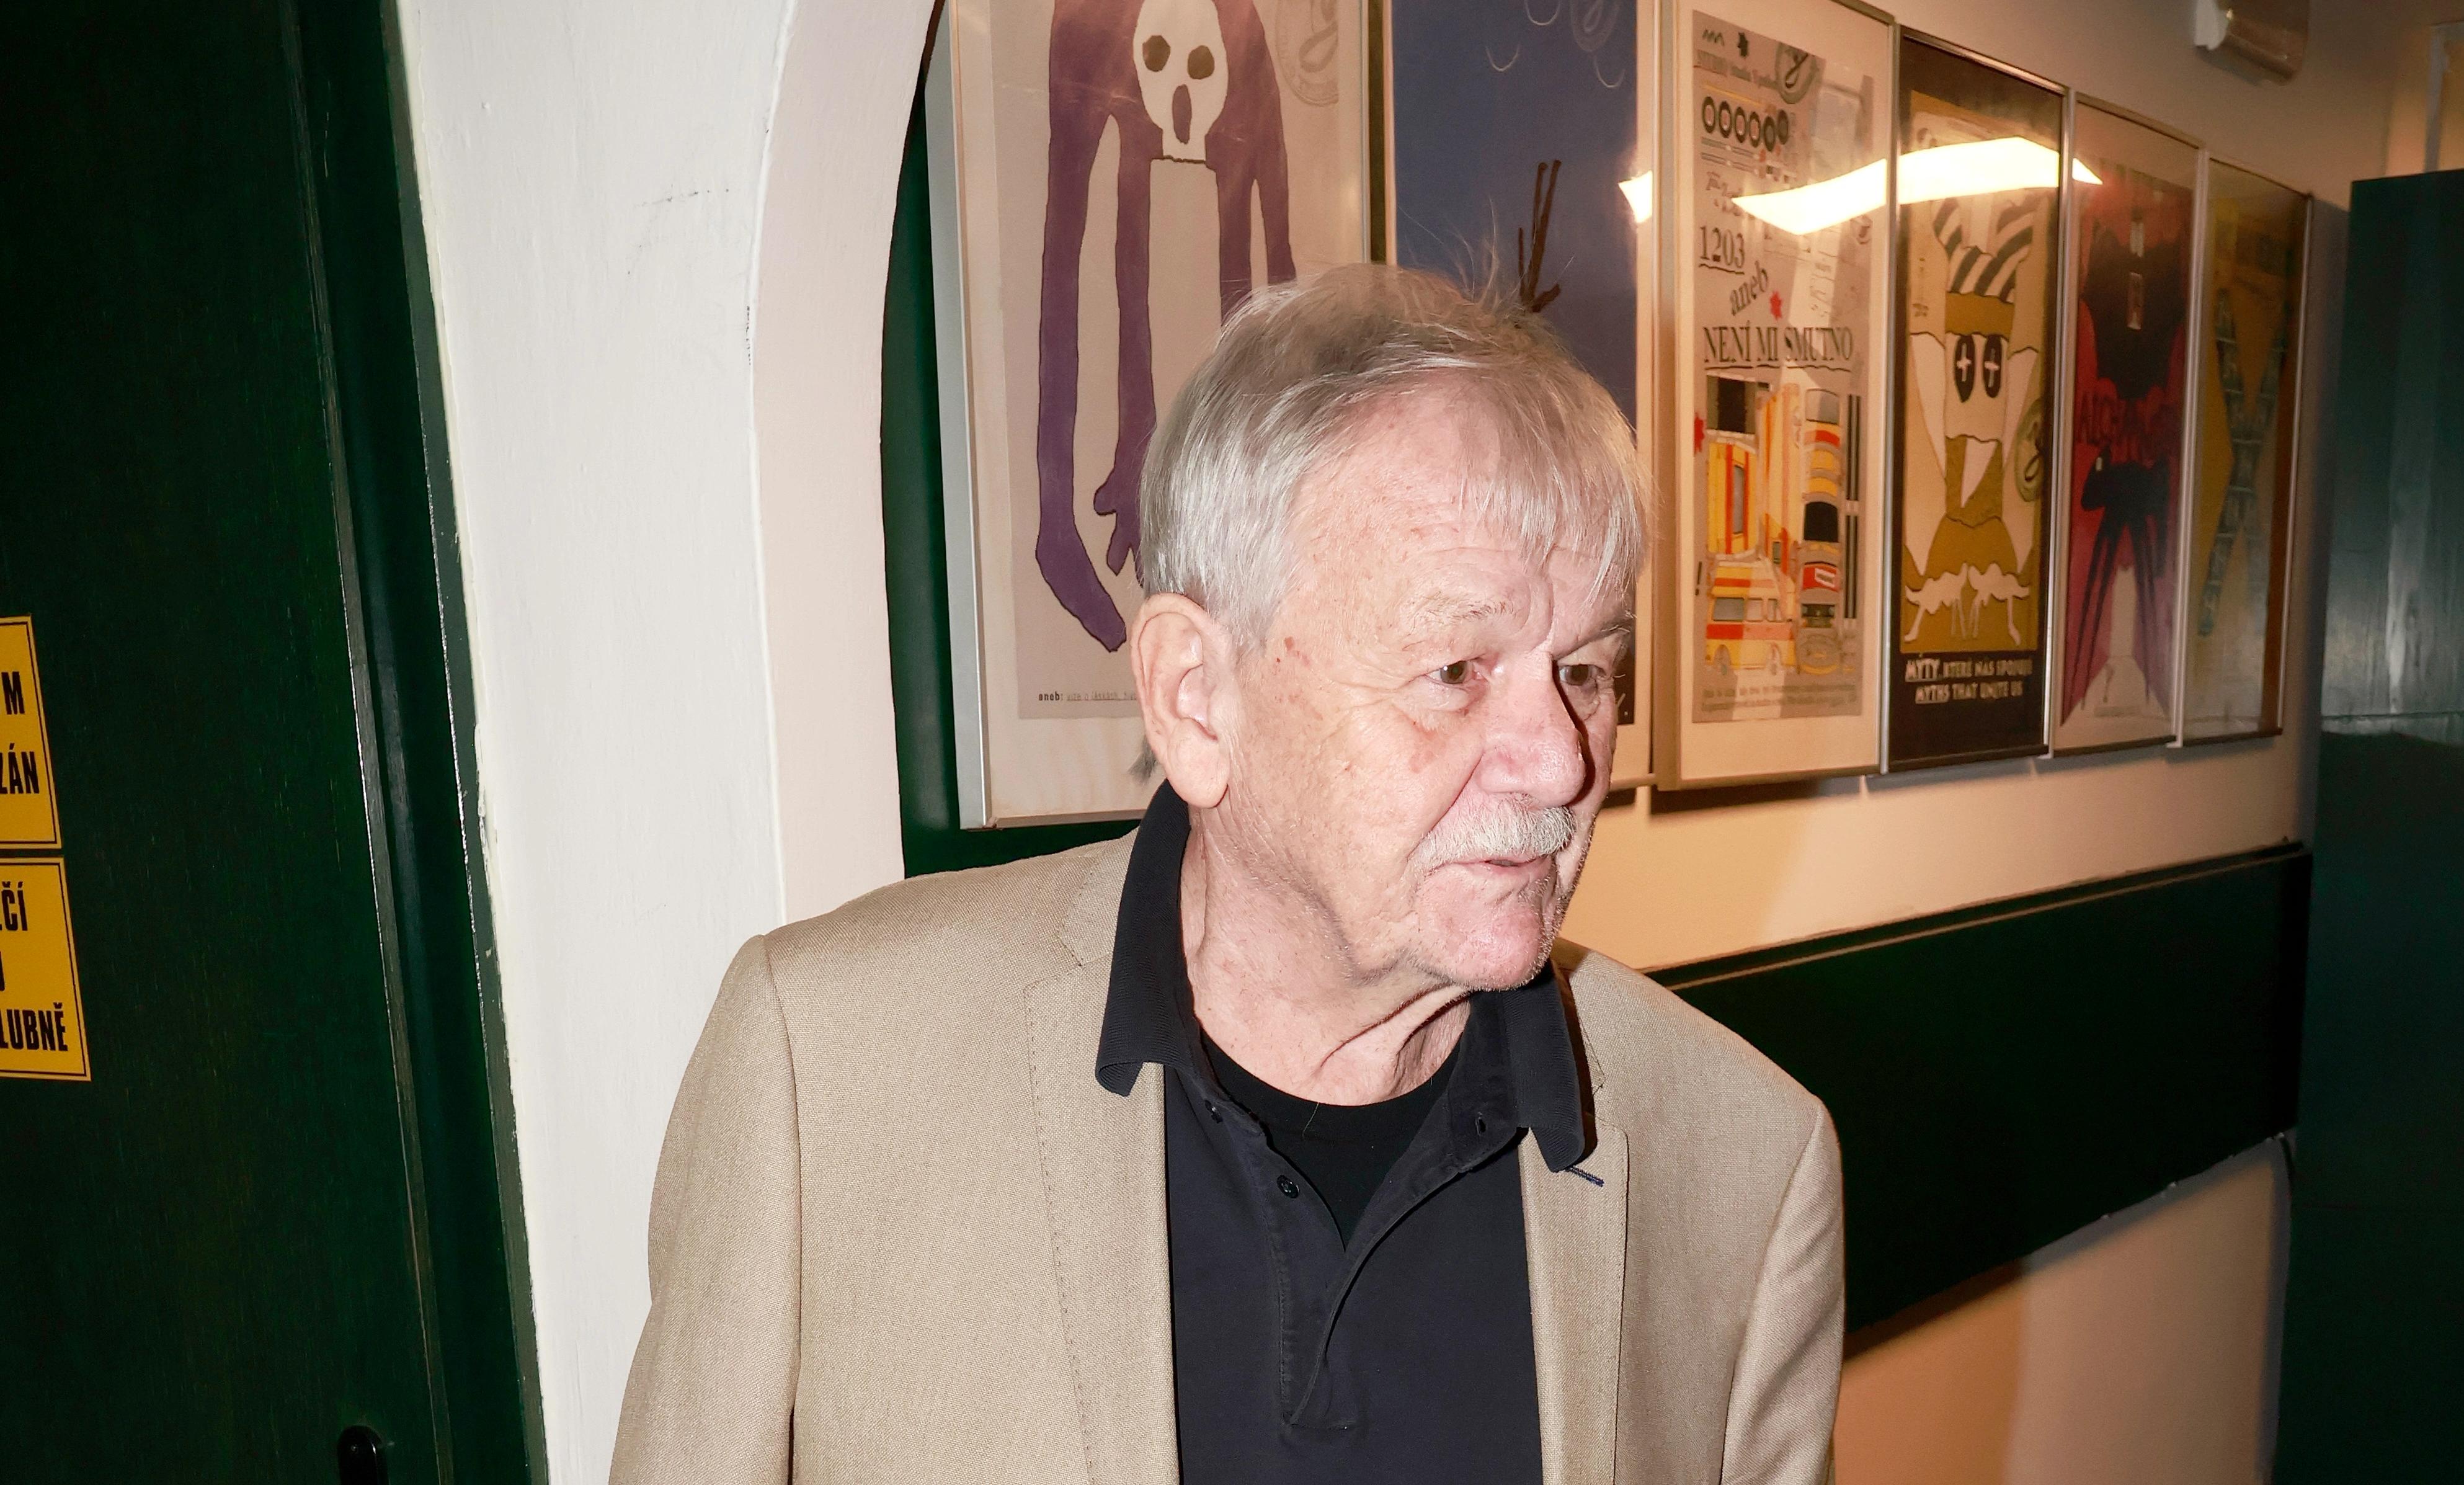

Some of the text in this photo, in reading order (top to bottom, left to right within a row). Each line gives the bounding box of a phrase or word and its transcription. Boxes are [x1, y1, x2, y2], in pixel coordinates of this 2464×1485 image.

[1704, 320, 1854, 363] NENÍ MI SMUTNO
[0, 881, 28, 931] ČÍ
